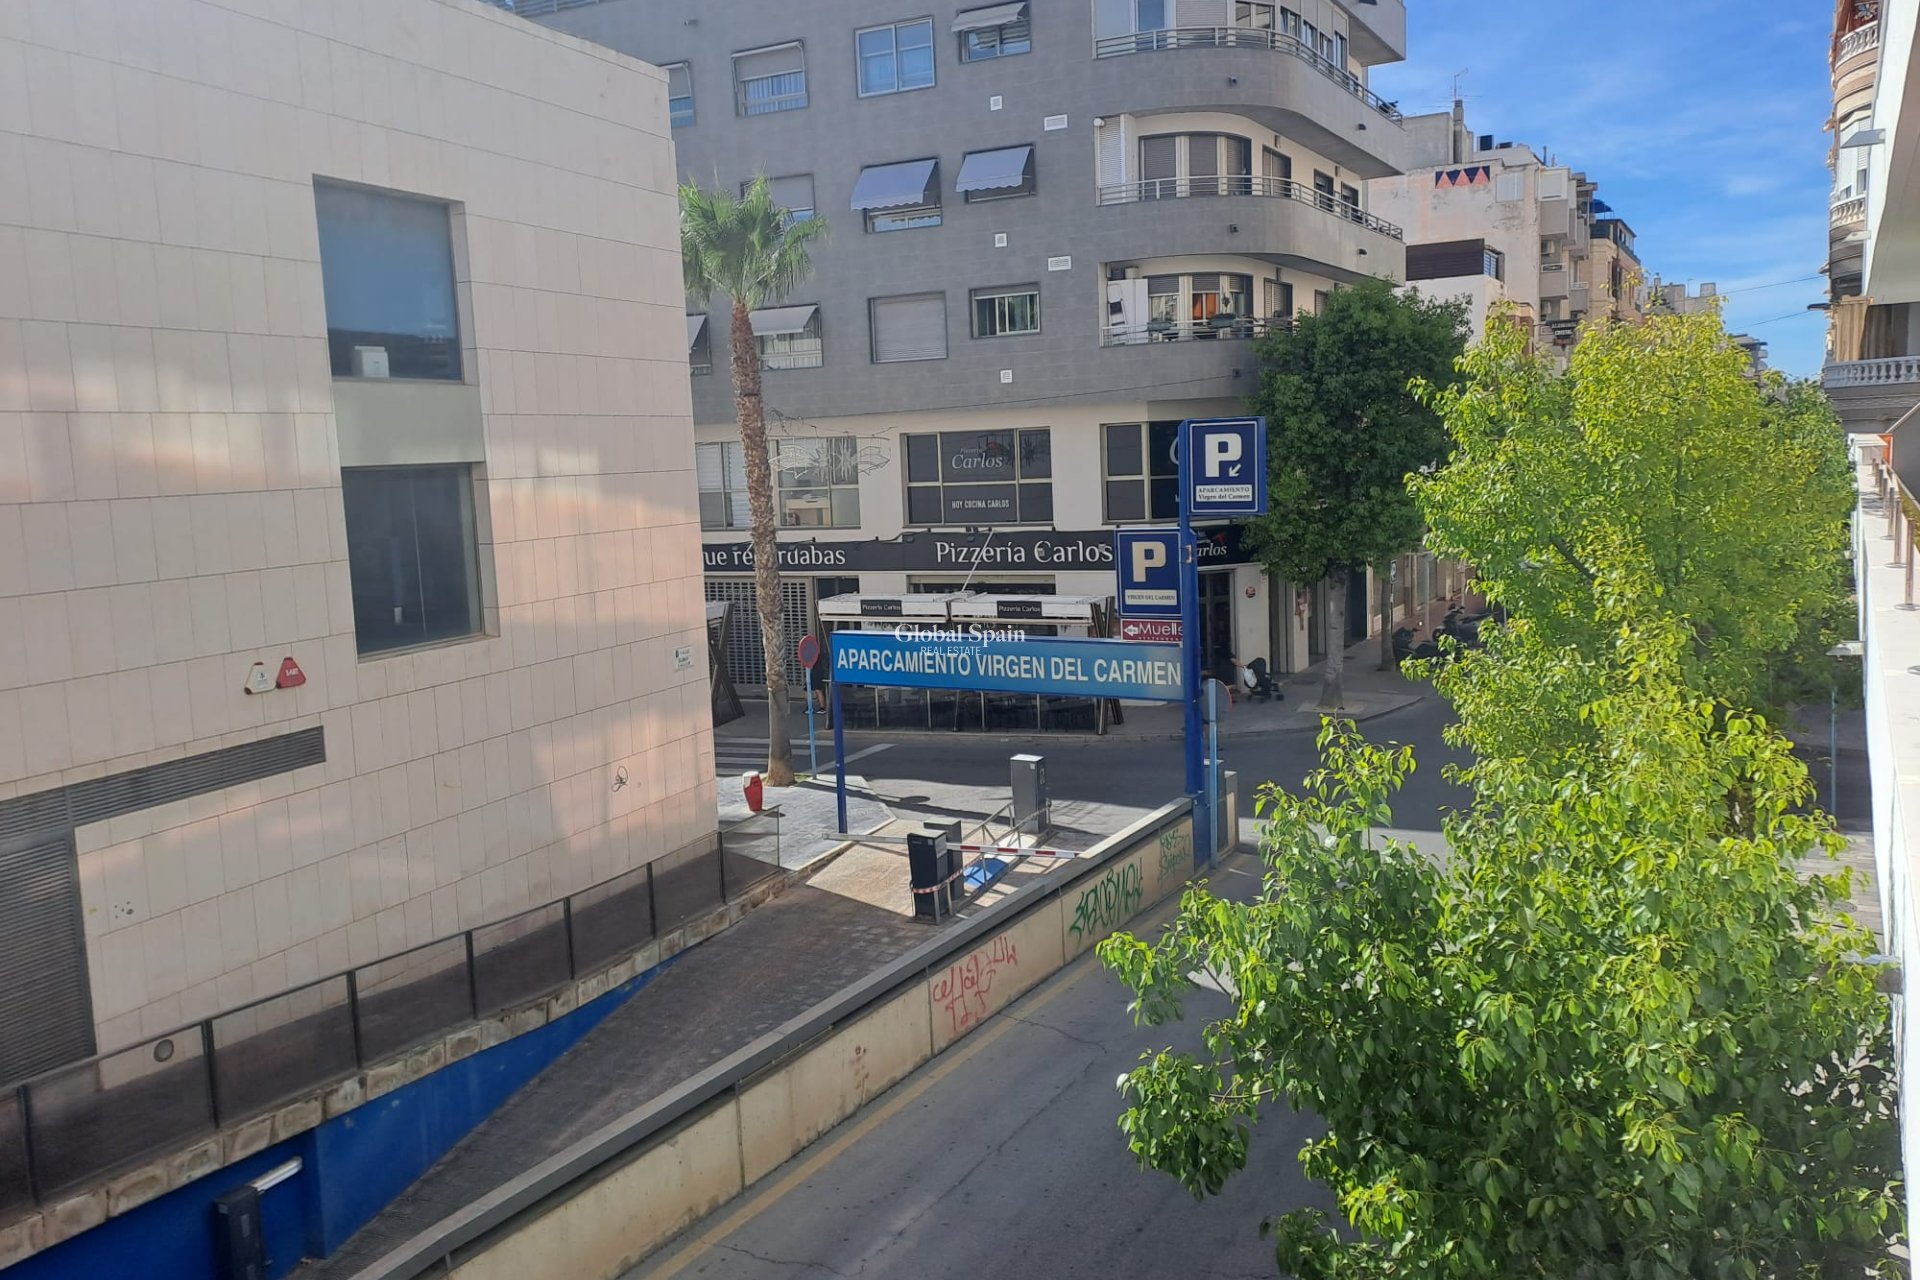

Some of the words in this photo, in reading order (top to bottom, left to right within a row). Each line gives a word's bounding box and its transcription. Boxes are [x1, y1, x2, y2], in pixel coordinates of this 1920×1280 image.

[951, 453, 1003, 469] Carlos
[1205, 432, 1242, 478] P
[951, 500, 963, 509] HOY
[964, 500, 986, 509] COCINA
[987, 499, 1010, 508] CARLOS
[935, 540, 1026, 563] Pizzería
[1033, 539, 1113, 563] Carlos
[1196, 542, 1228, 557] arlos
[1131, 541, 1166, 583] P
[837, 648, 971, 676] APARCAMIENTO
[976, 654, 1045, 679] VIRGEN
[1051, 657, 1089, 681] DEL
[1093, 659, 1182, 687] CARMEN
